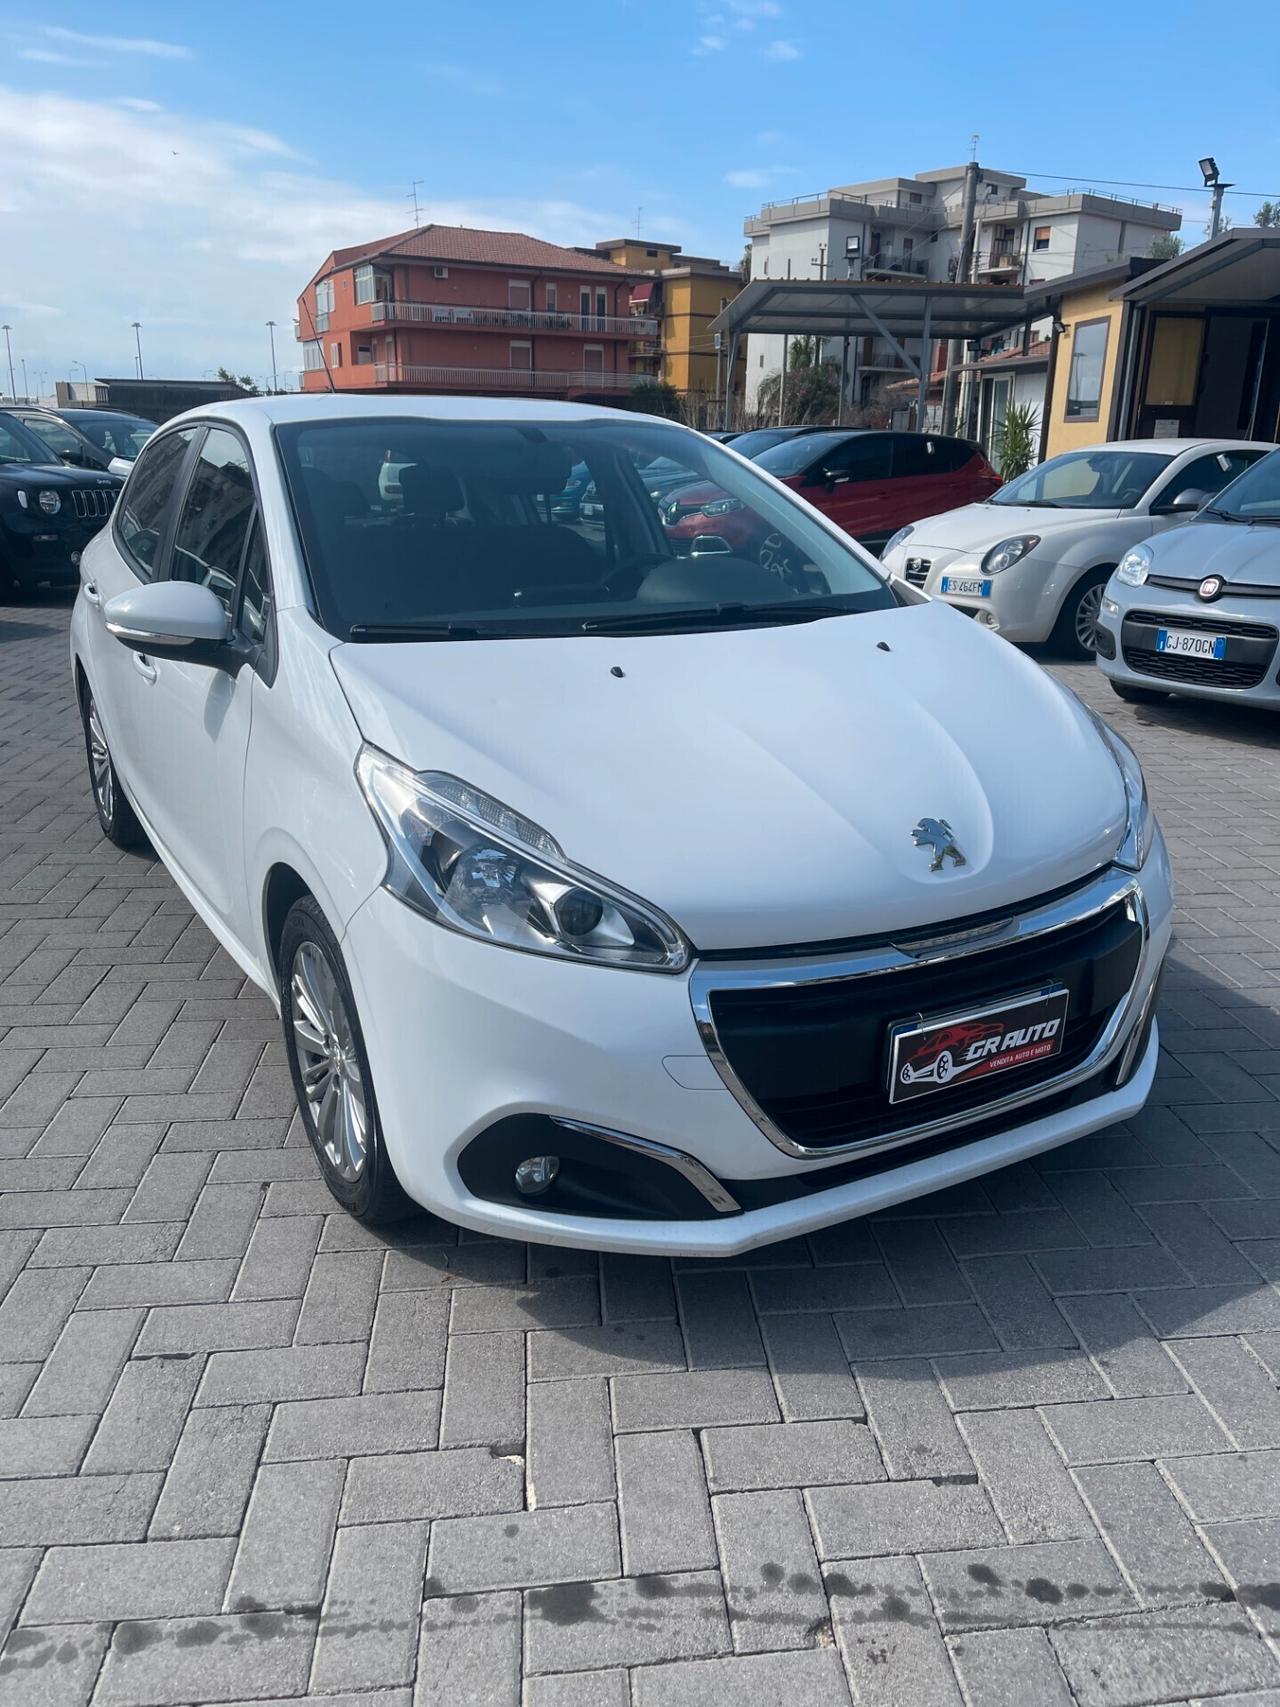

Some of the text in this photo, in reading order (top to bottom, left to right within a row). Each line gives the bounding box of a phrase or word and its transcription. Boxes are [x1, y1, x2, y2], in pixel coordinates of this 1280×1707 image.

[965, 1018, 1061, 1061] GR AUTO
[989, 1056, 1014, 1068] VENDITA
[1014, 1051, 1030, 1062] AUTO
[1035, 1044, 1051, 1056] MOTO
